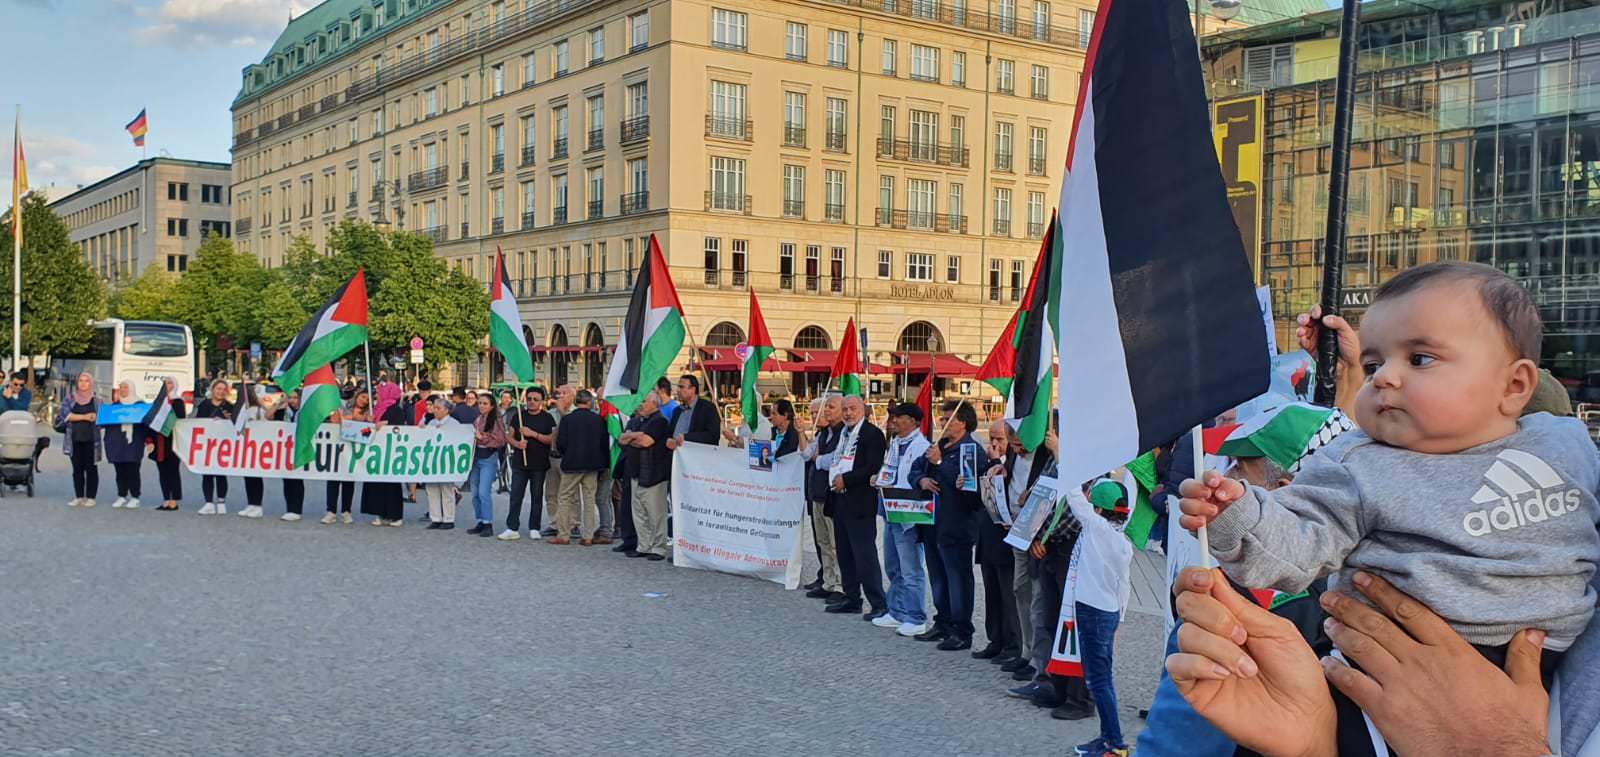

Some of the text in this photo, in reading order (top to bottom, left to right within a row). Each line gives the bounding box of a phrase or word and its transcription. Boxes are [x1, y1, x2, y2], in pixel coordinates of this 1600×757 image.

[891, 285, 954, 300] HOTEL ADLON
[188, 426, 473, 476] Freiheit ür Palästina
[1463, 488, 1581, 537] adidas
